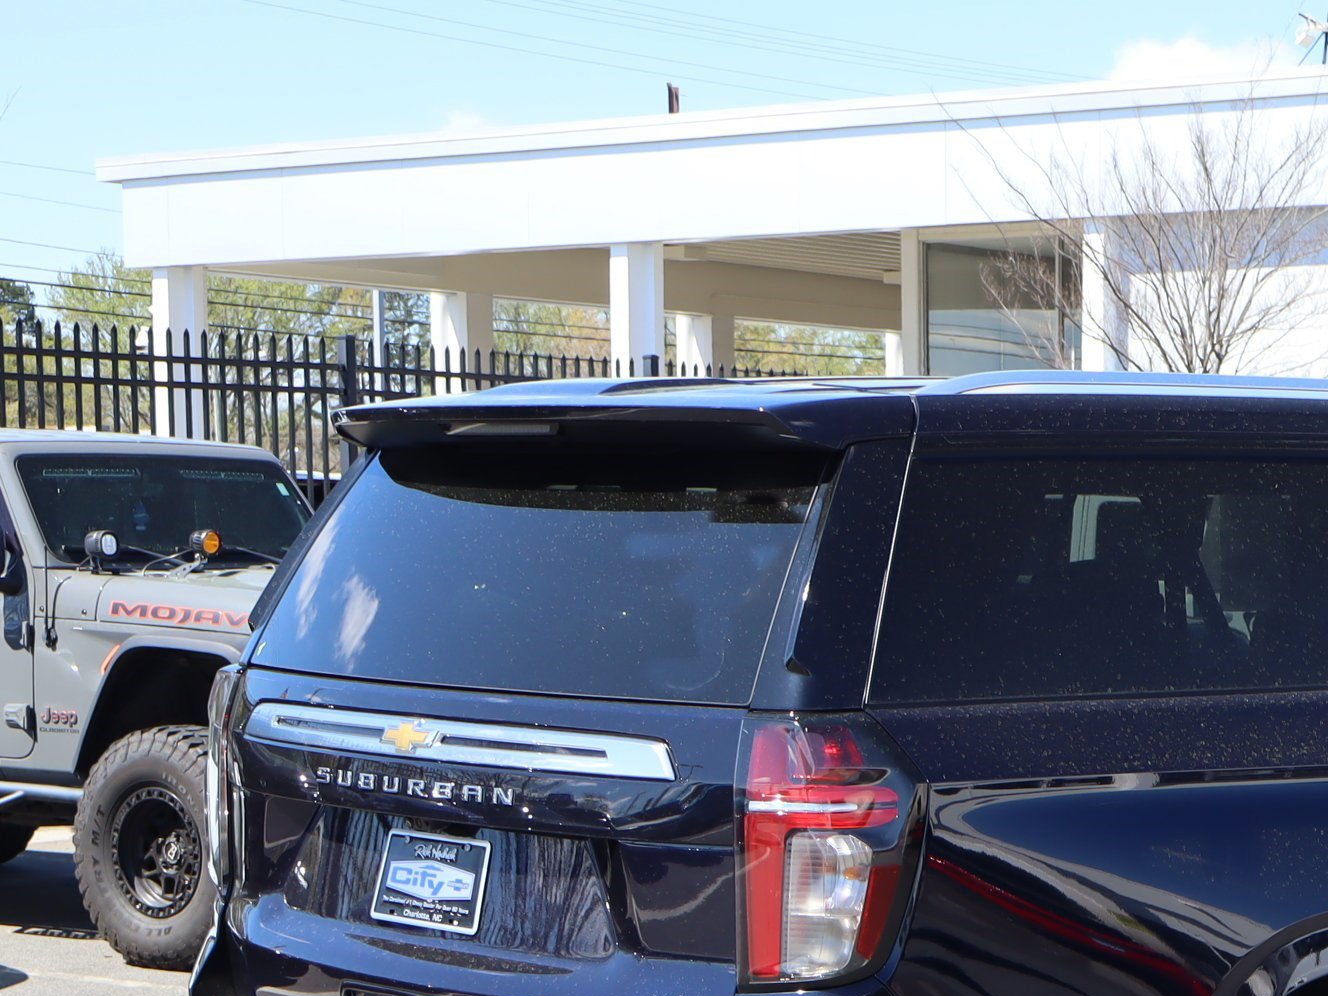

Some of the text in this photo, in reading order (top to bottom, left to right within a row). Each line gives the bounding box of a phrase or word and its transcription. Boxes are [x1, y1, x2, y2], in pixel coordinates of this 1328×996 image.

[111, 600, 249, 628] MOJAV
[40, 705, 78, 728] Jeep
[316, 766, 514, 806] SUBURBAN
[391, 866, 445, 896] City
